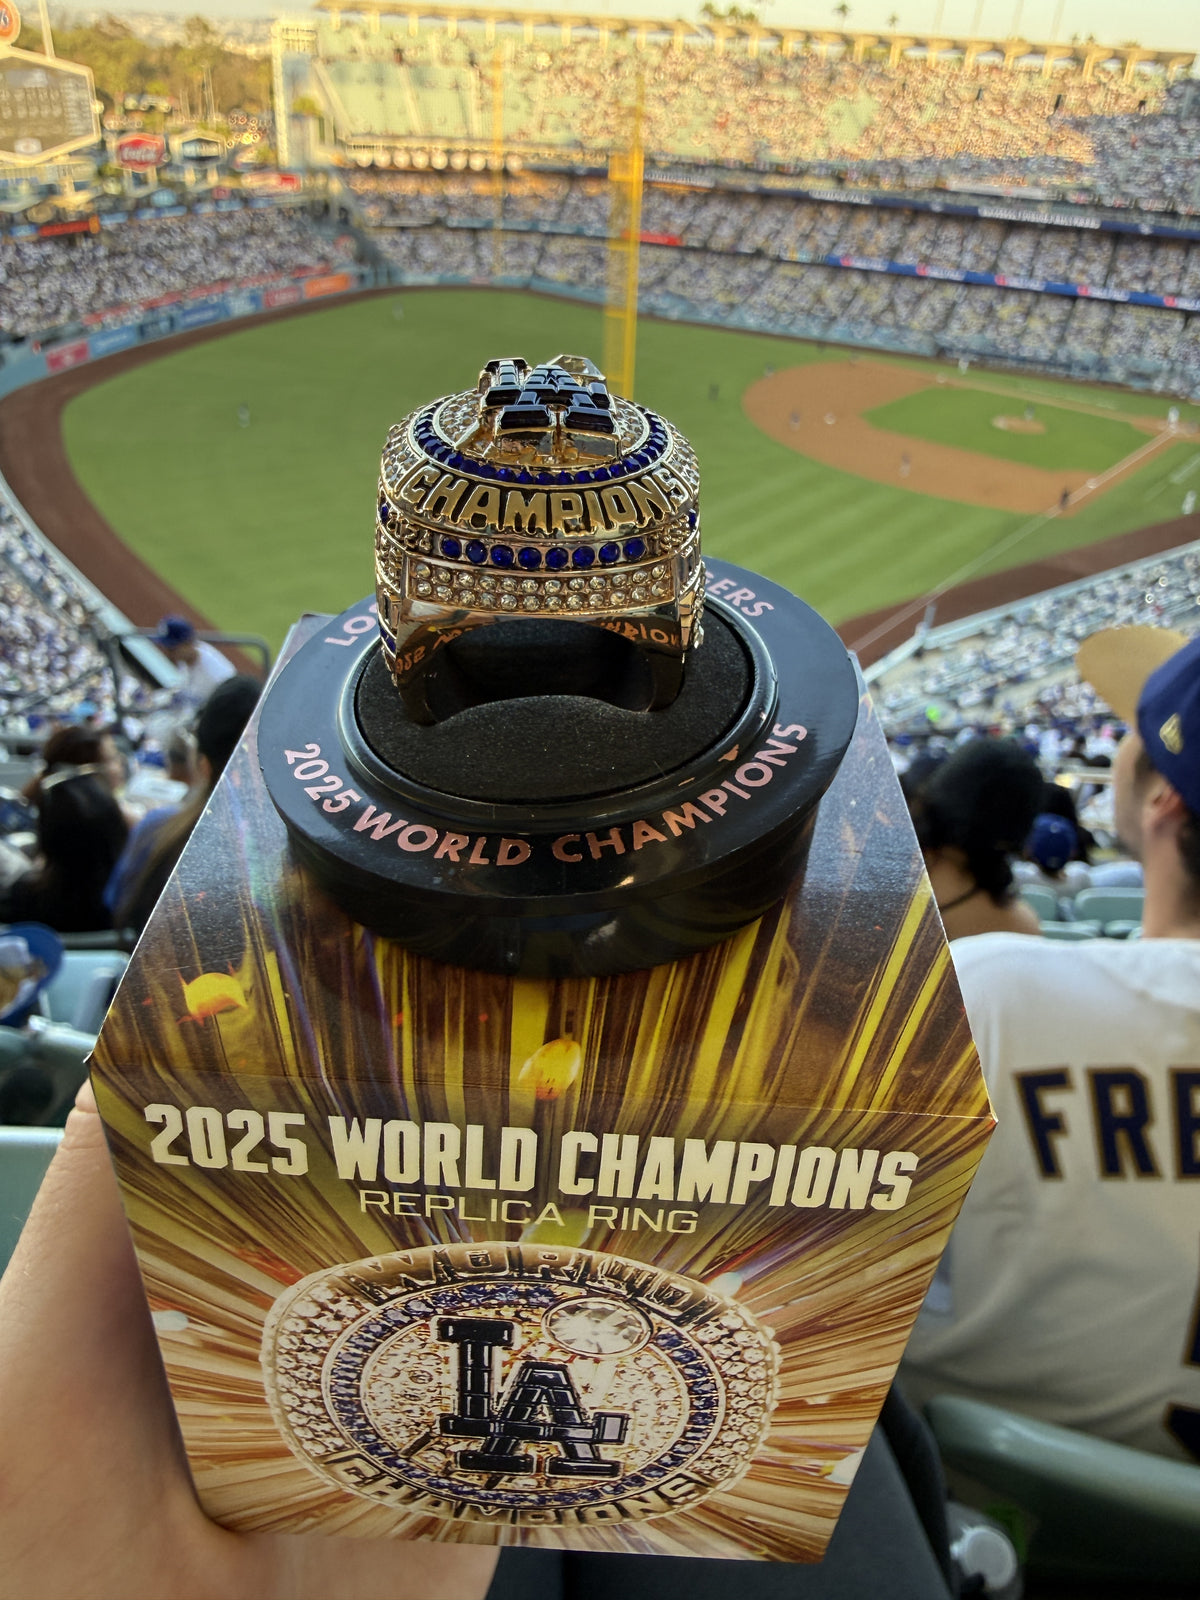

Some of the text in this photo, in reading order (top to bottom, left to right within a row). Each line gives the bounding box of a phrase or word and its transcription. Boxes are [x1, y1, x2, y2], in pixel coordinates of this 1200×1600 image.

[400, 464, 691, 534] CHAMPIONS
[284, 722, 808, 866] 2025 WORLD CHAMPIONS
[144, 1103, 920, 1211] 2025 WORLD CHAMPIONS
[359, 1189, 699, 1234] REPLICA RING
[436, 1314, 631, 1479] LA
[336, 1462, 708, 1528] CHAMPIONS
